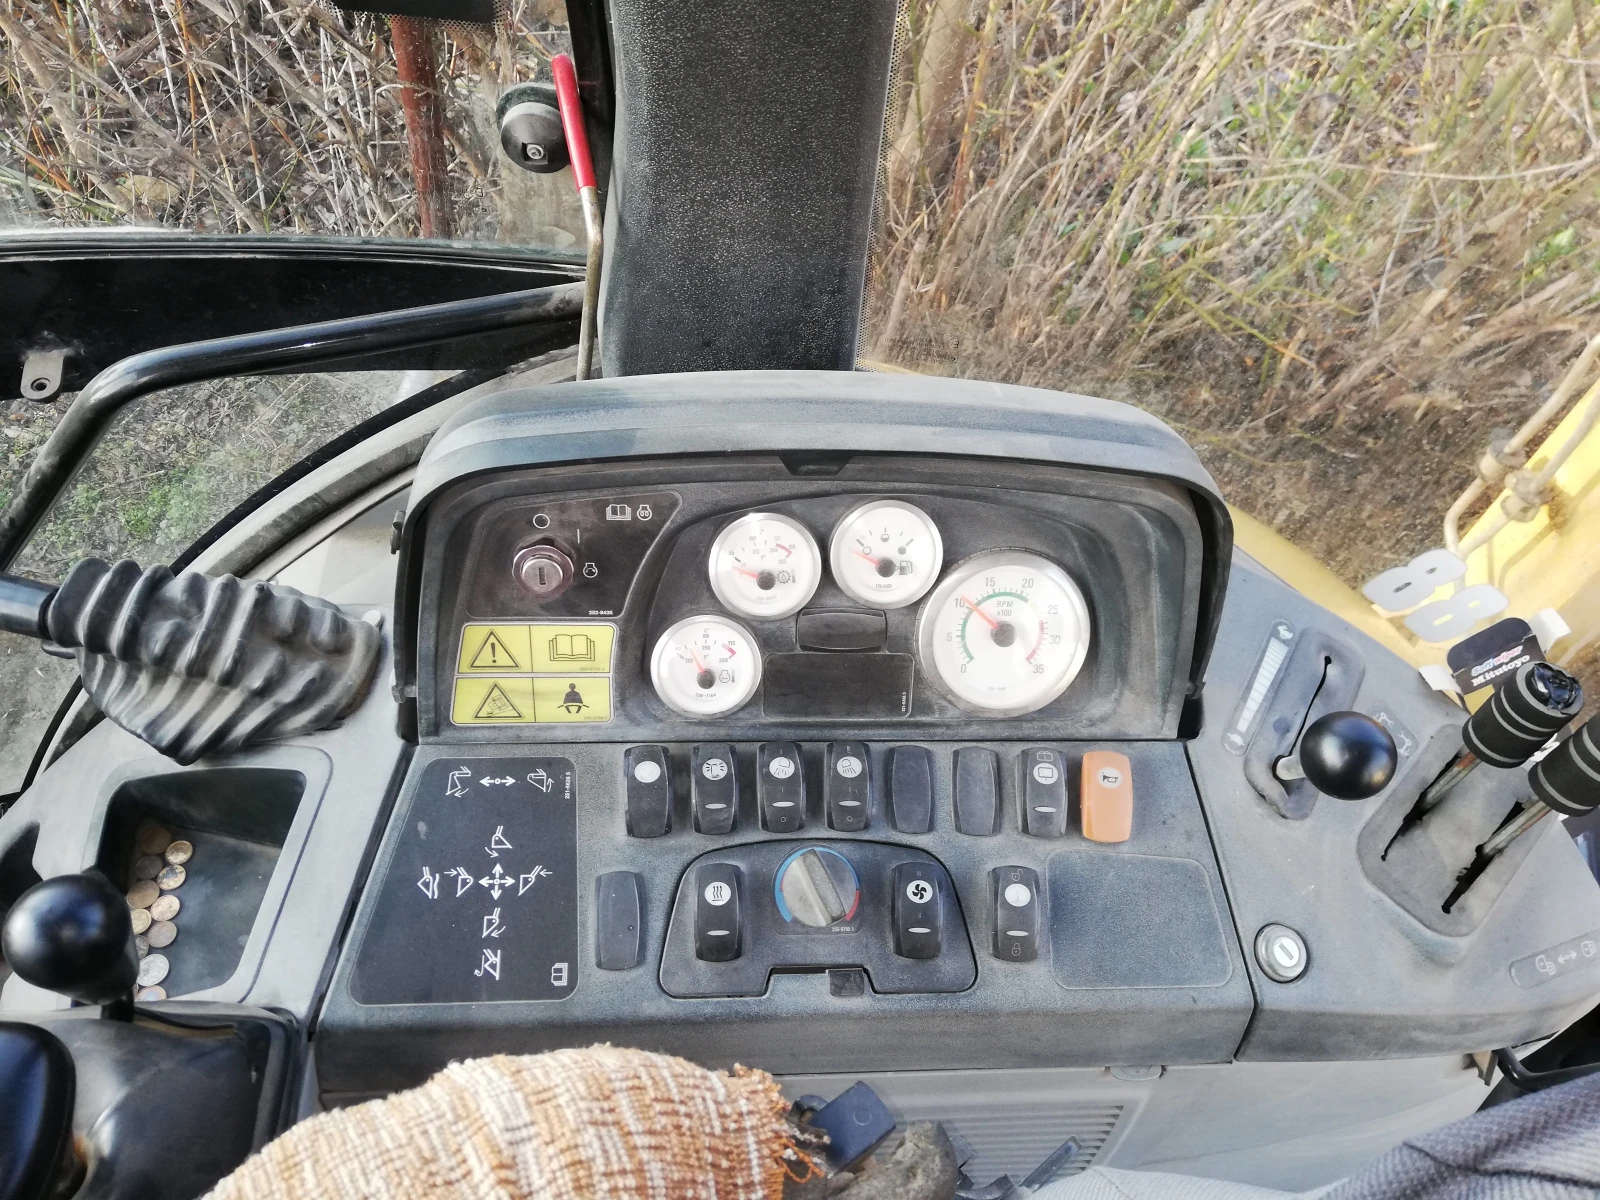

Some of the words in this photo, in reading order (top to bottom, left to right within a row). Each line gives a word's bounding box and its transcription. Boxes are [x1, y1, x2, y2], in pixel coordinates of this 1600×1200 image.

[984, 577, 996, 587] 15
[1021, 578, 1034, 588] 20
[954, 598, 966, 608] 10
[996, 600, 1014, 608] RPM
[1047, 605, 1059, 614] 25
[946, 632, 953, 641] 5
[1049, 635, 1061, 645] 30
[960, 664, 967, 673] 0
[1032, 664, 1045, 674] 35
[1470, 655, 1530, 687] Mitutoyo
